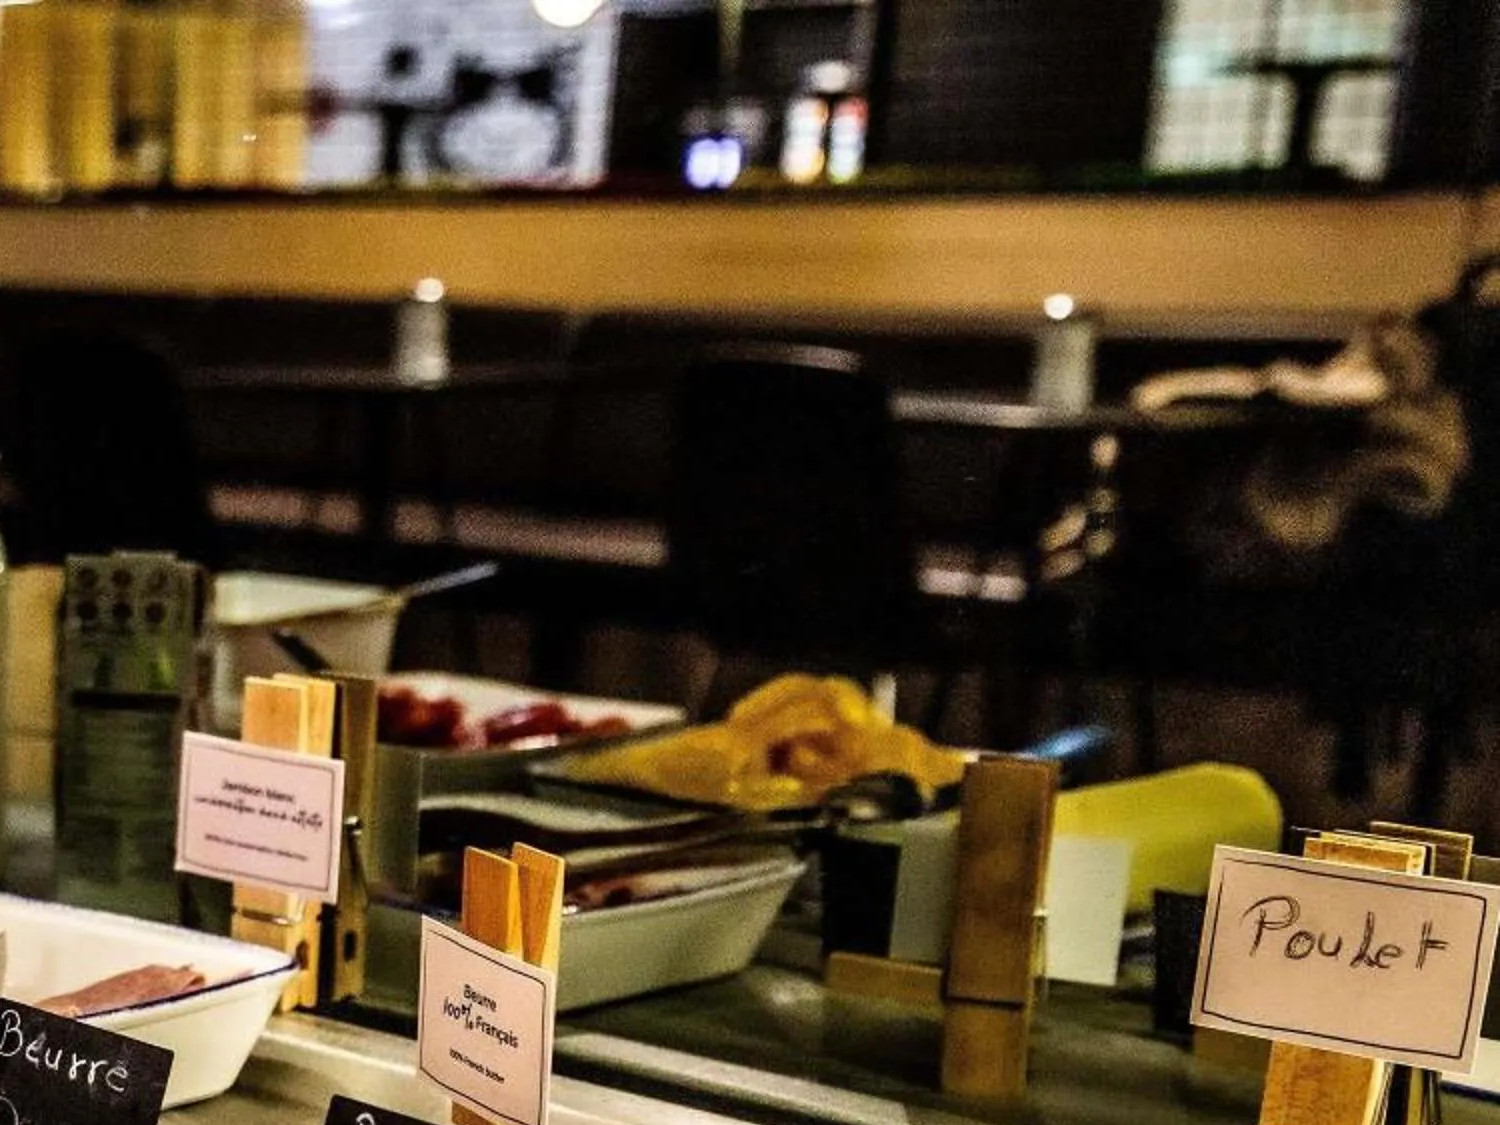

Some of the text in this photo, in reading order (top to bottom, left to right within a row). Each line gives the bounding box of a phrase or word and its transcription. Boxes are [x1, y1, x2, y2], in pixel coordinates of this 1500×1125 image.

[1240, 895, 1449, 970] Poulet
[463, 984, 497, 1013] Beurre
[476, 1016, 519, 1048] Français
